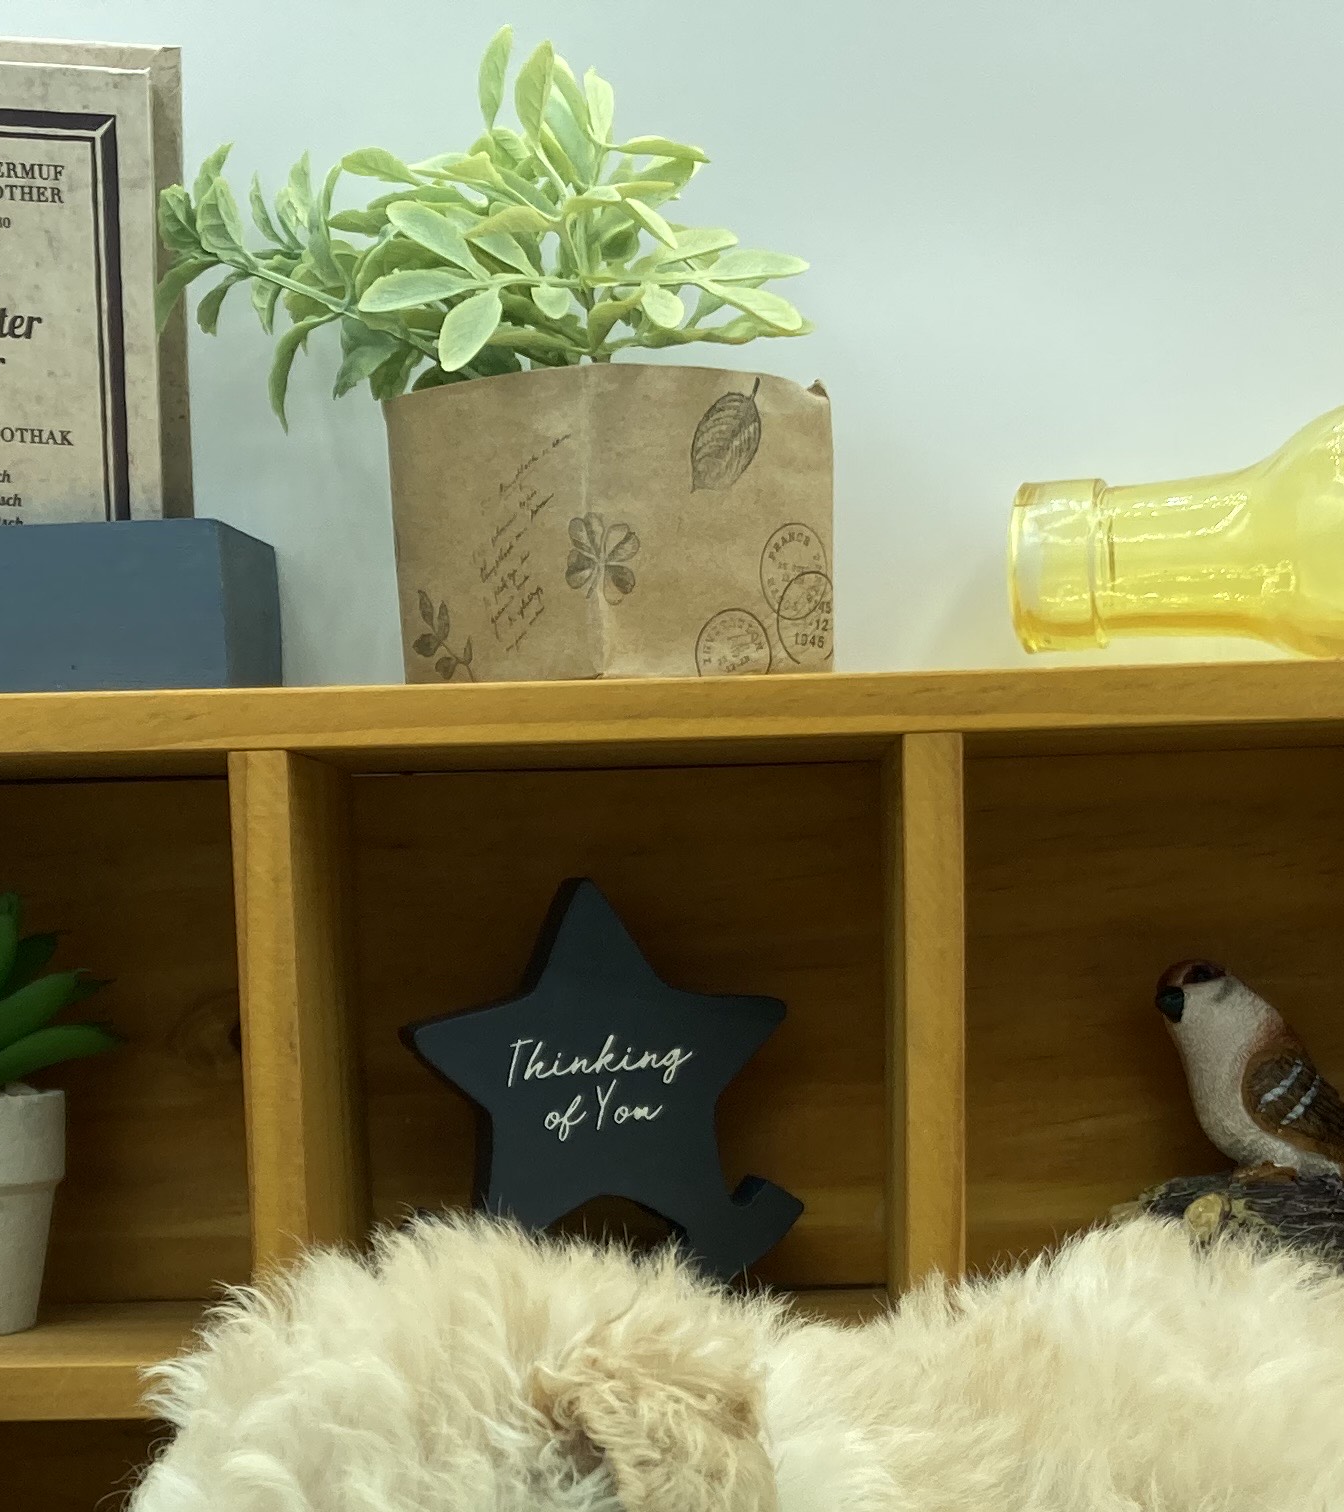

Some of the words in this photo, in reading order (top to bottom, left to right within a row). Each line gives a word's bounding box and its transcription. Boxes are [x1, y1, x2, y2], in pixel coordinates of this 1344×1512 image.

[507, 1034, 693, 1088] Thinking
[544, 1095, 587, 1142] of
[595, 1079, 663, 1131] You
